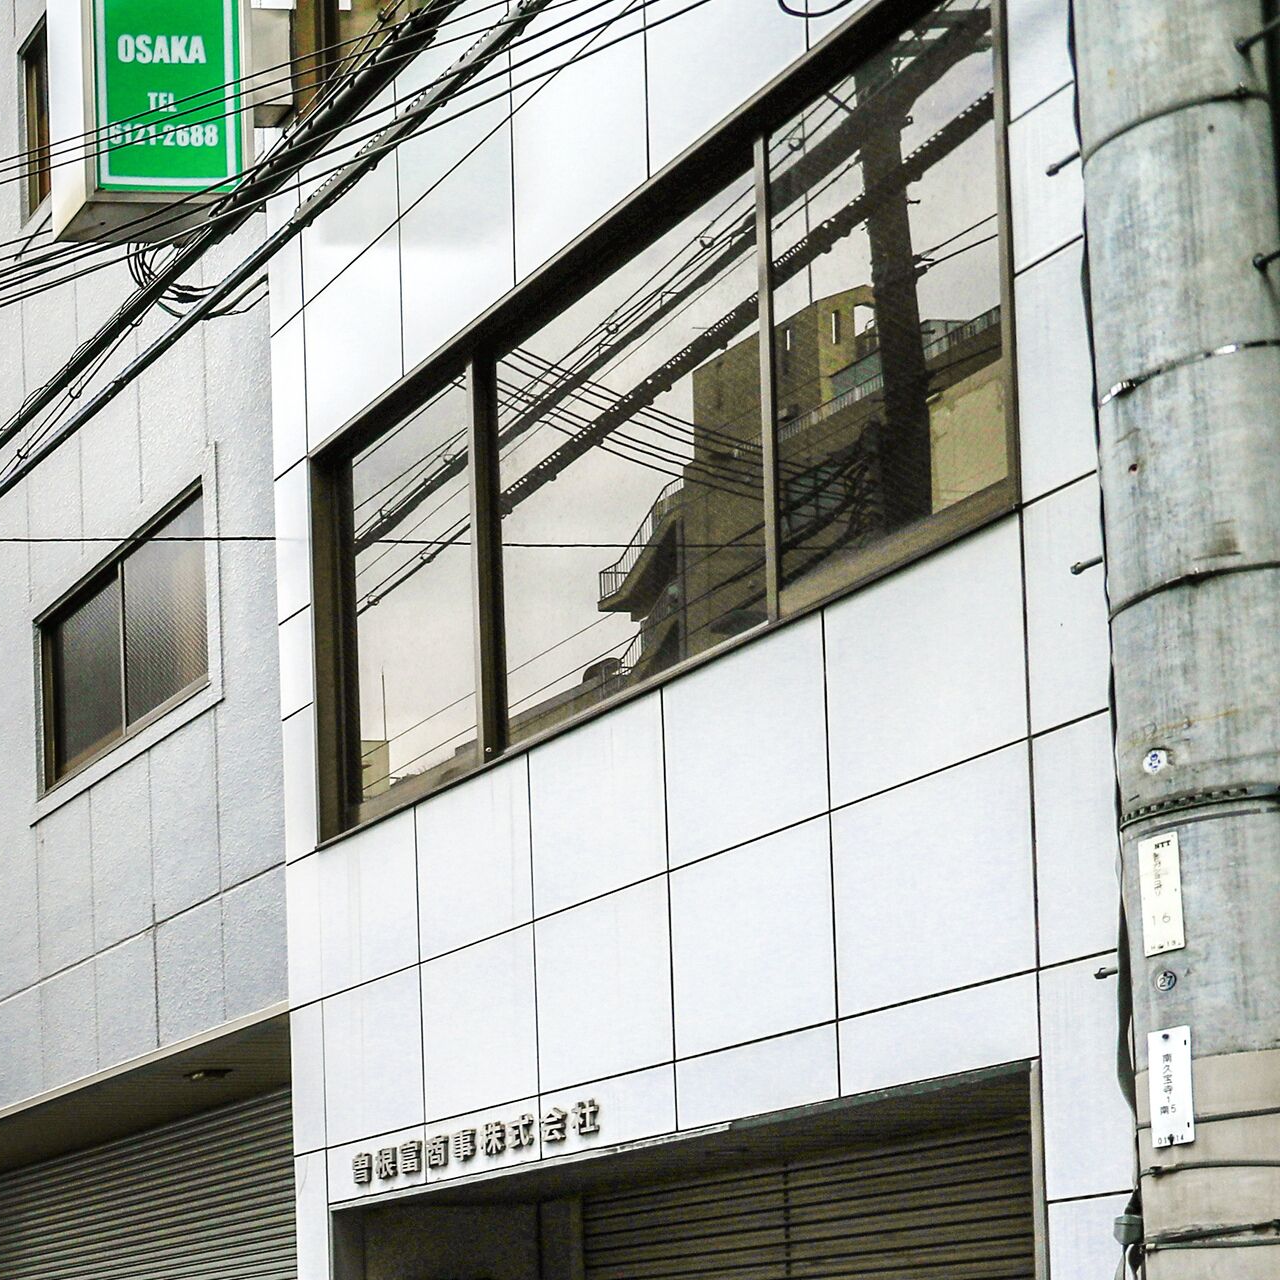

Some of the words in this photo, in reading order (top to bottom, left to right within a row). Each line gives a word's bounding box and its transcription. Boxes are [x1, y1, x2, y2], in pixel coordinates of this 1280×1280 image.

[117, 34, 207, 64] OSAKA
[147, 92, 177, 113] TEL
[1154, 840, 1171, 850] NTT
[1159, 976, 1173, 988] 27
